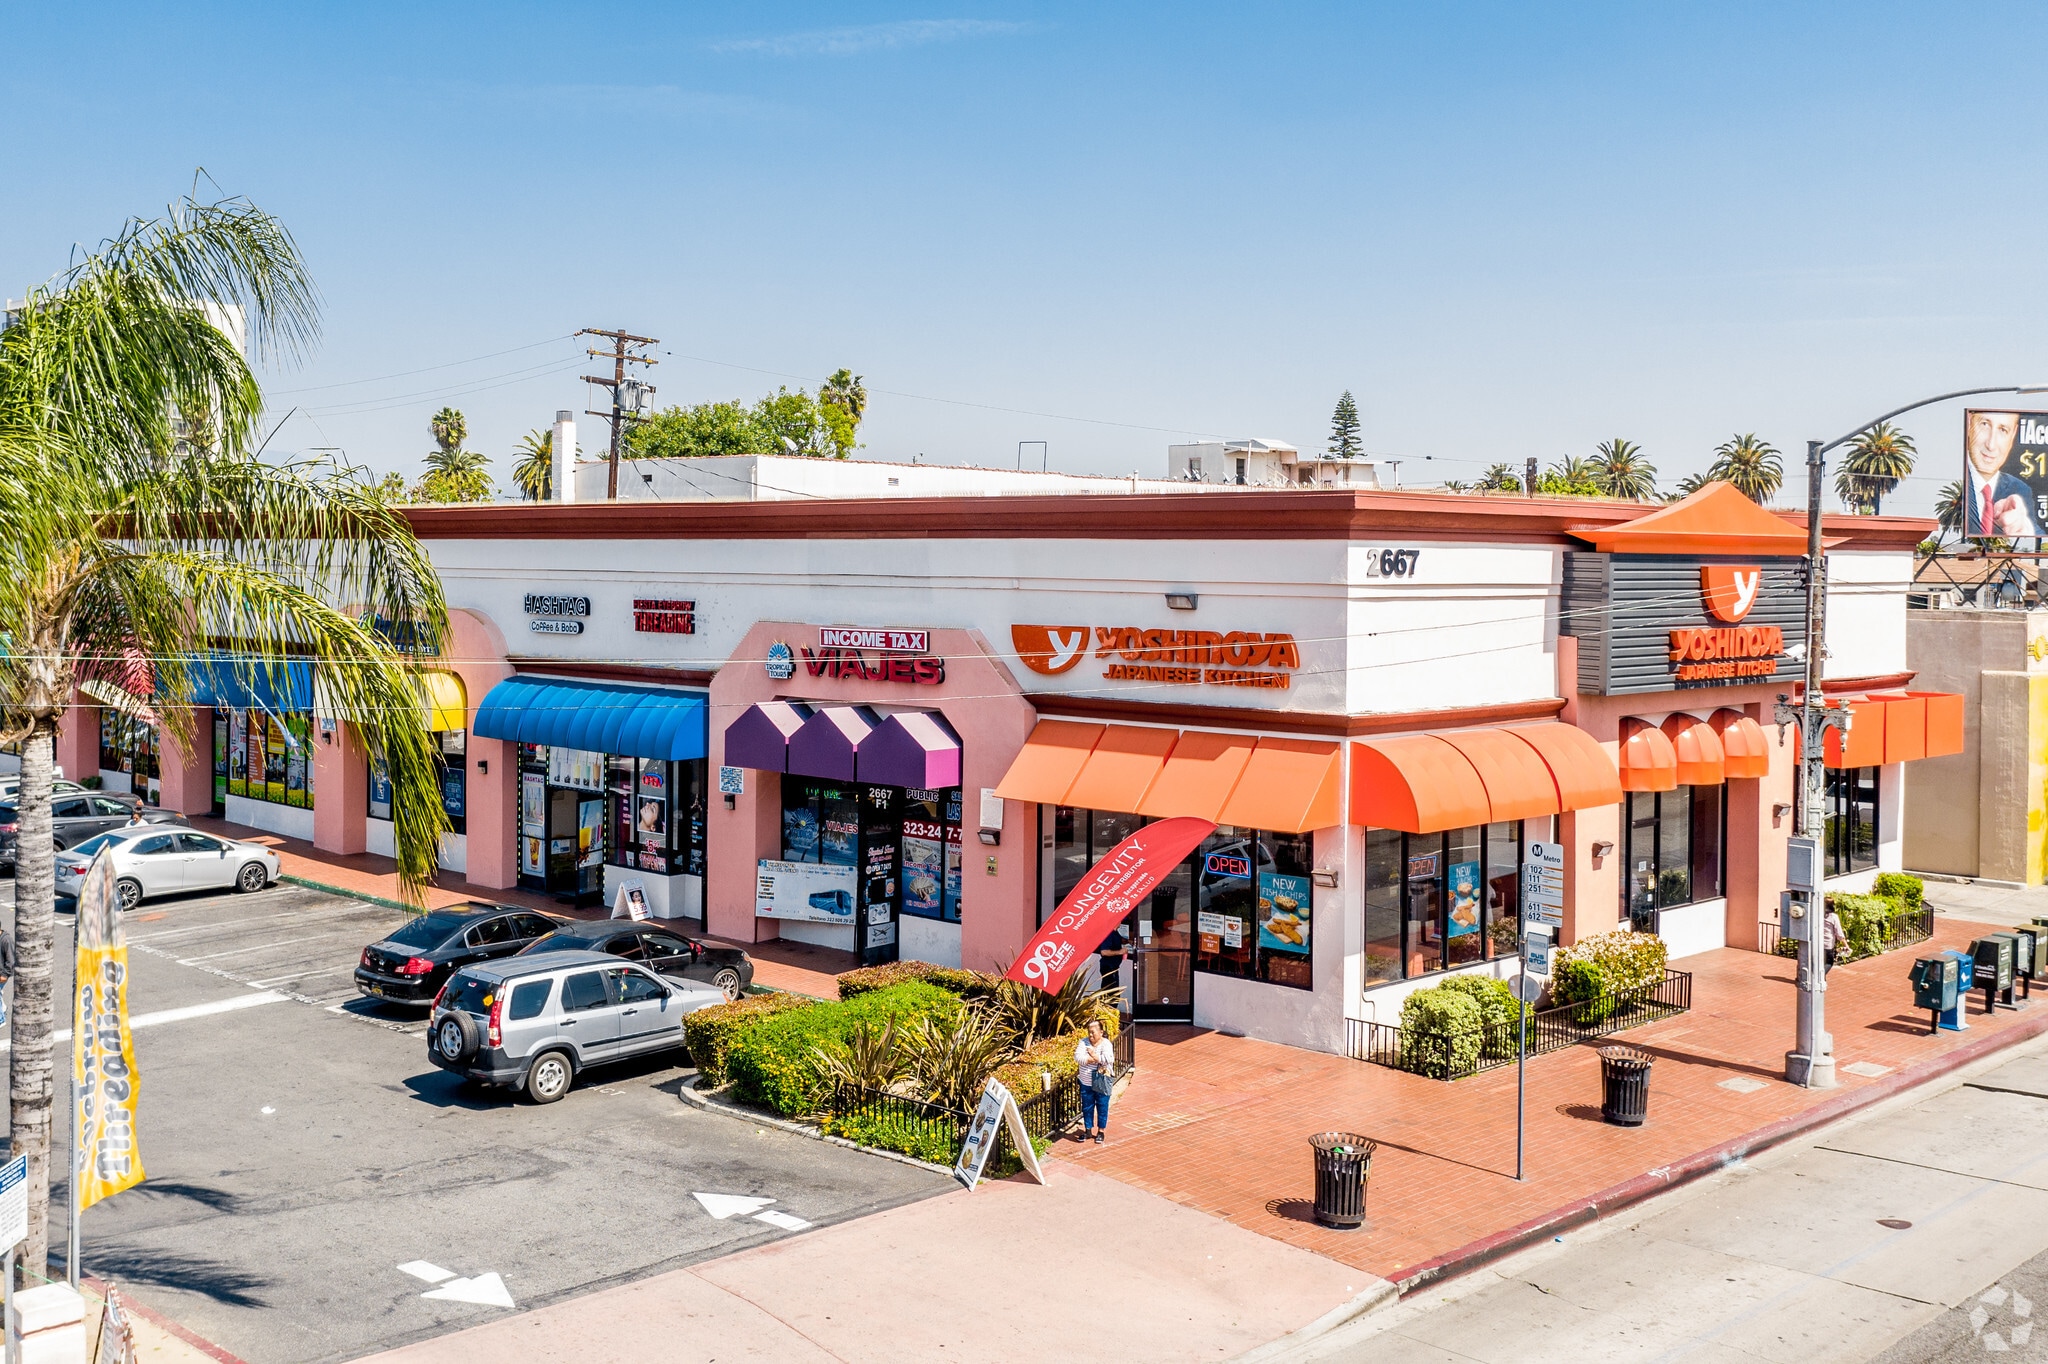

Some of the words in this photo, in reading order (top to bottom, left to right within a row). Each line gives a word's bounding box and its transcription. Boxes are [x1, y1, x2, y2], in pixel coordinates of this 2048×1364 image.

[1366, 548, 1420, 578] 2667
[524, 594, 591, 616] HASHTAG
[530, 621, 554, 633] Coffee
[554, 622, 561, 633] &
[561, 622, 578, 634] Boba
[633, 611, 696, 634] THREADING
[823, 630, 886, 647] INCOME
[888, 632, 923, 649] TAX
[1669, 626, 1785, 661] YOSHINOYA
[1095, 626, 1300, 669] YOSHINOYA
[765, 663, 791, 673] TROPICAL
[800, 648, 946, 685] VIAJES
[1676, 663, 1736, 681] JAPANESE
[1736, 660, 1777, 676] KITCHEN
[1102, 664, 1202, 683] JAPANESE
[1203, 669, 1290, 689] KITCHEN
[642, 775, 663, 788] OPEN
[869, 787, 893, 800] 2667
[906, 789, 940, 803] PUBLIC
[875, 798, 887, 809] F1
[946, 803, 961, 820] LAS
[826, 820, 858, 834] VIAJES
[903, 821, 942, 838] 323-24
[904, 860, 927, 869] Income
[929, 863, 941, 871] Tax
[1207, 855, 1249, 876] OPEN
[1543, 854, 1561, 864] Metro
[1456, 865, 1472, 878] NEW
[1530, 865, 1543, 875] 102
[1136, 876, 1155, 894] SALUD
[1272, 877, 1297, 891] NEW
[1528, 874, 1541, 883] 111
[1073, 894, 1110, 931] INDEPENDENT
[1108, 857, 1146, 895] DISTRIBUTOR
[1262, 887, 1278, 897] FISH
[1285, 891, 1307, 901] CHIPS
[1528, 884, 1541, 893] 251
[1528, 902, 1540, 912] 611
[1528, 912, 1541, 920] 612
[1050, 940, 1073, 967] LIFE
[1530, 952, 1544, 960] BUS
[96, 958, 131, 1181] Threading
